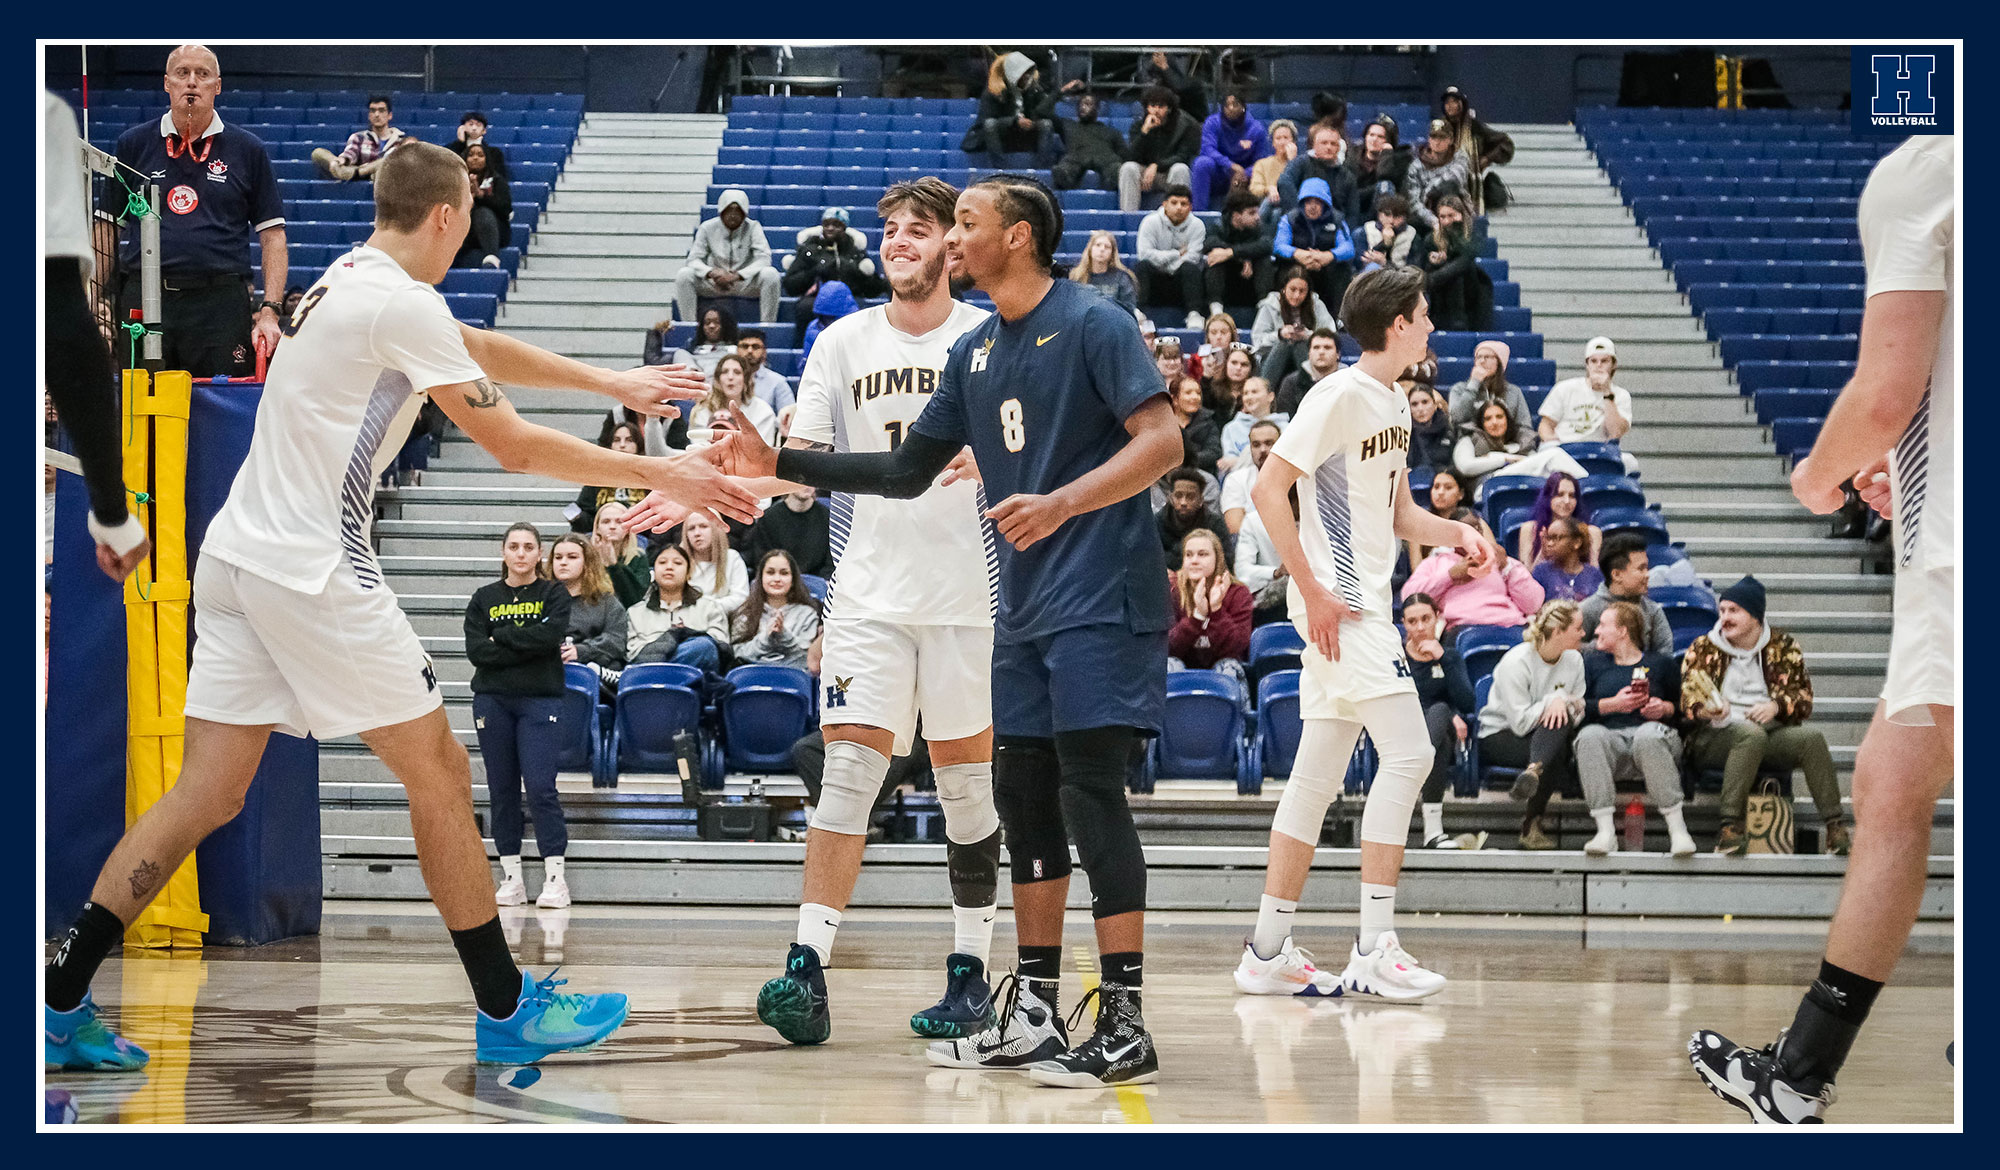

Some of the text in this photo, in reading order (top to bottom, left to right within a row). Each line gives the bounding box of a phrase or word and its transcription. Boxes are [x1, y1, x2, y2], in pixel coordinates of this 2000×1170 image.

[283, 285, 330, 339] 3
[851, 366, 945, 412] HUMB
[884, 420, 918, 453] 1
[1000, 397, 1026, 453] 8
[826, 685, 847, 709] H
[53, 927, 79, 967] CAN
